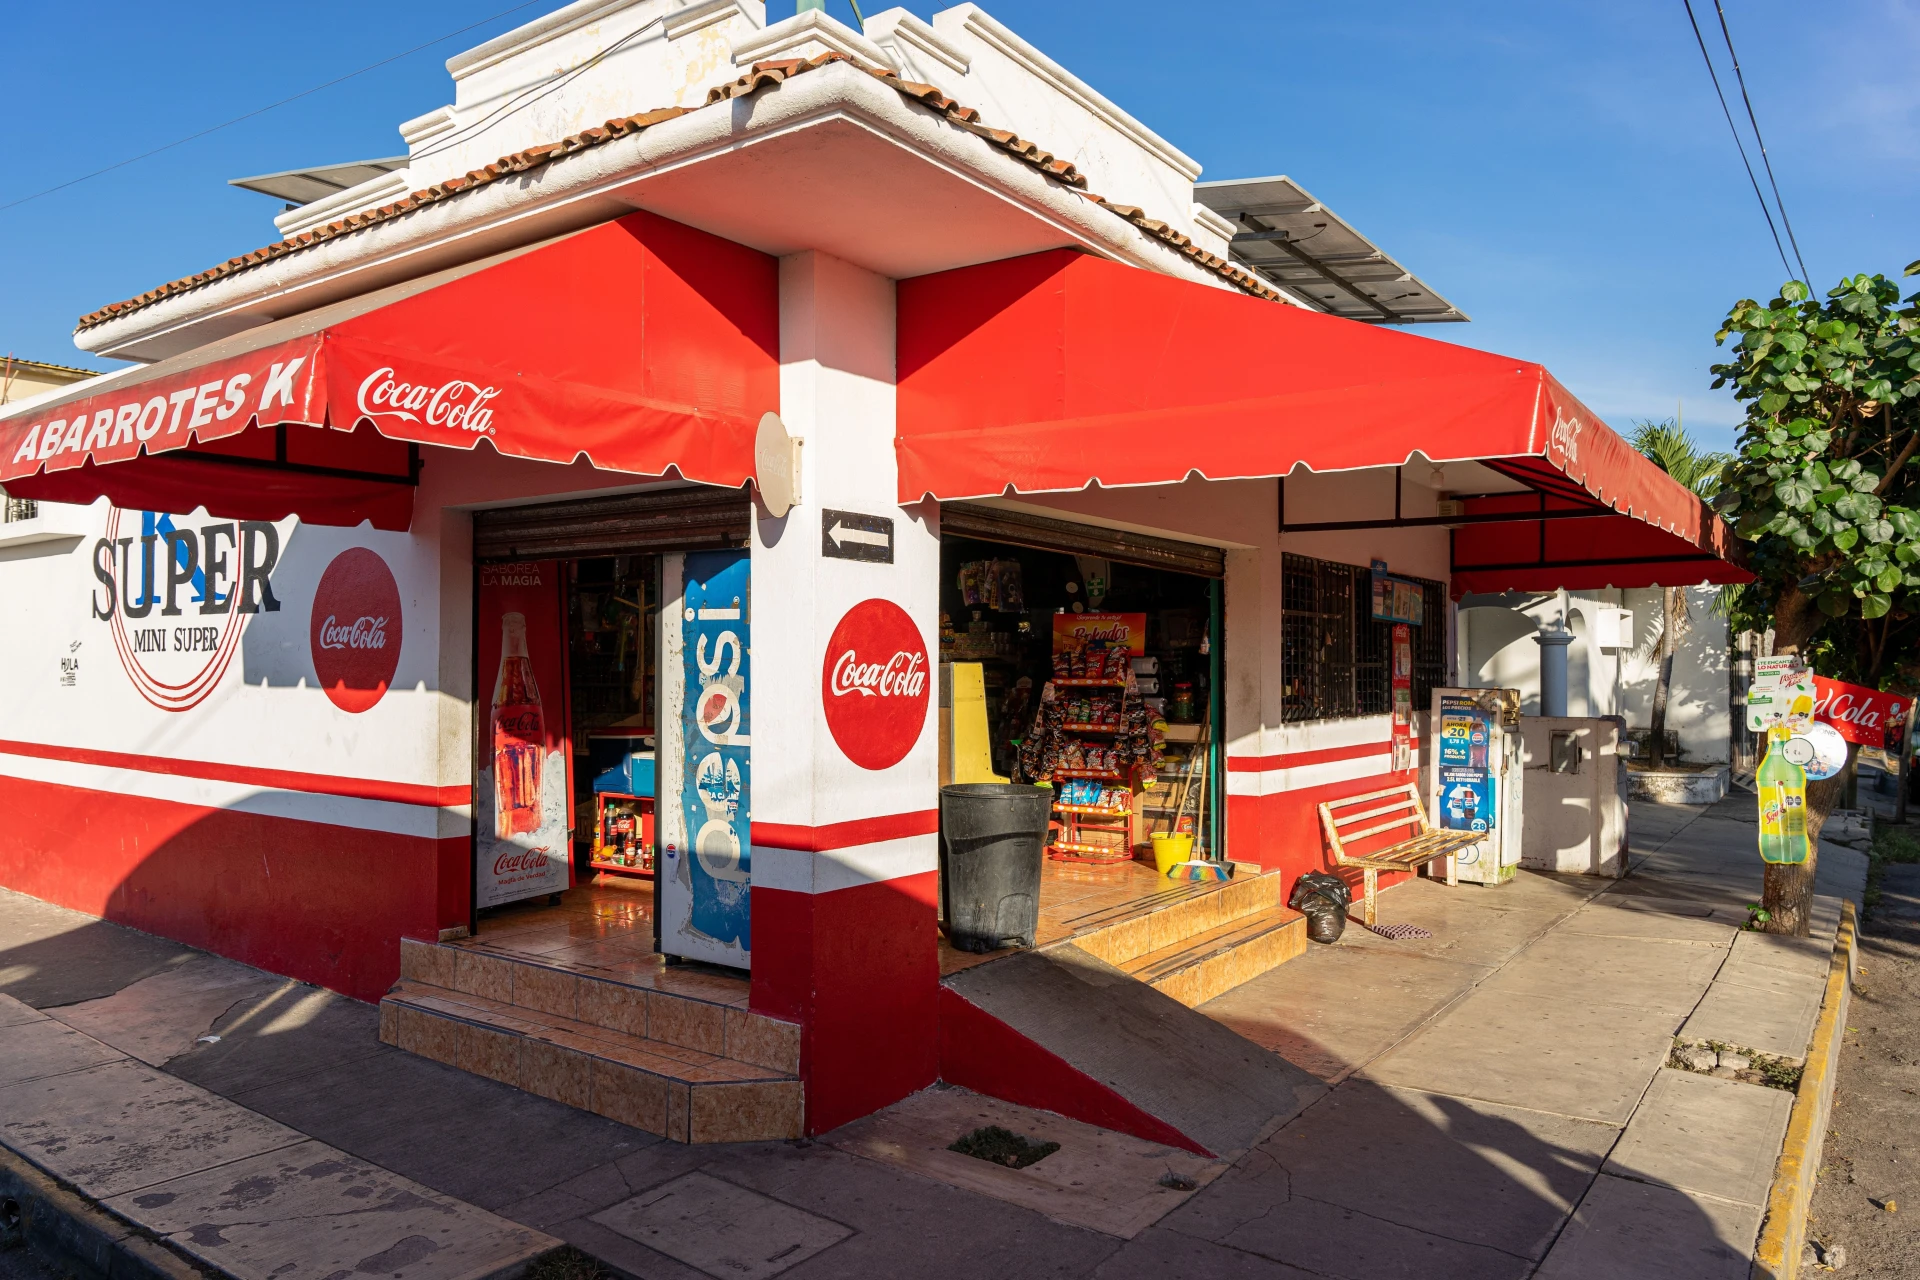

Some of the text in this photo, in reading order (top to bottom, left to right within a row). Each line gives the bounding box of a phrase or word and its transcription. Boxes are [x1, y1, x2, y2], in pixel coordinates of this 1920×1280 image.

[12, 356, 307, 464] ABARROTES K
[357, 367, 502, 433] Coca-Cola
[92, 521, 281, 622] SUPER
[482, 563, 540, 574] SABOREA
[482, 576, 542, 586] LA MAGIA
[134, 626, 219, 652] MINI SUPER
[319, 615, 390, 650] Coca-Cola
[831, 649, 926, 697] Coca-Cola
[1828, 693, 1880, 728] Cola
[493, 845, 551, 876] Coca-Cola
